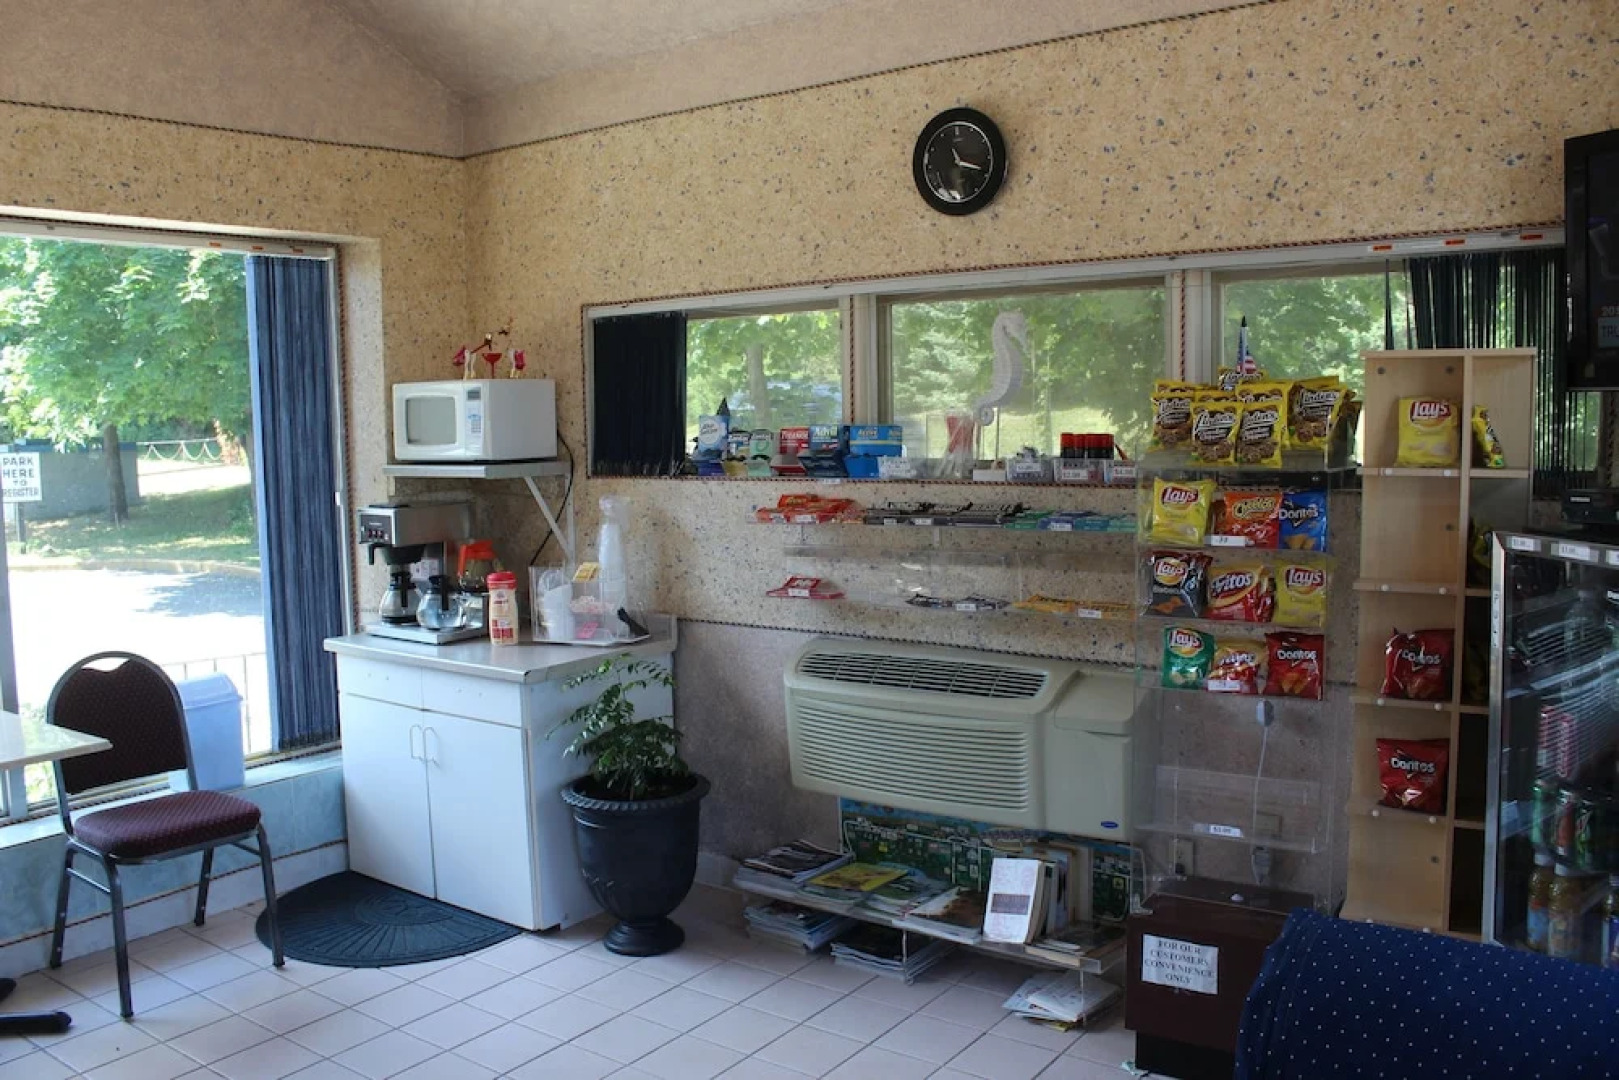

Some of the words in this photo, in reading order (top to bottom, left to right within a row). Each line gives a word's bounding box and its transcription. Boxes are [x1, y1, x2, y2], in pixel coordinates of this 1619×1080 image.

[3, 457, 33, 466] PARK
[3, 469, 34, 478] HERE
[1391, 757, 1436, 773] Doritos
[1159, 940, 1178, 950] FOR
[1180, 944, 1201, 954] OUR
[1144, 959, 1213, 977] CONVENIENCE
[1165, 973, 1191, 984] ONLY
